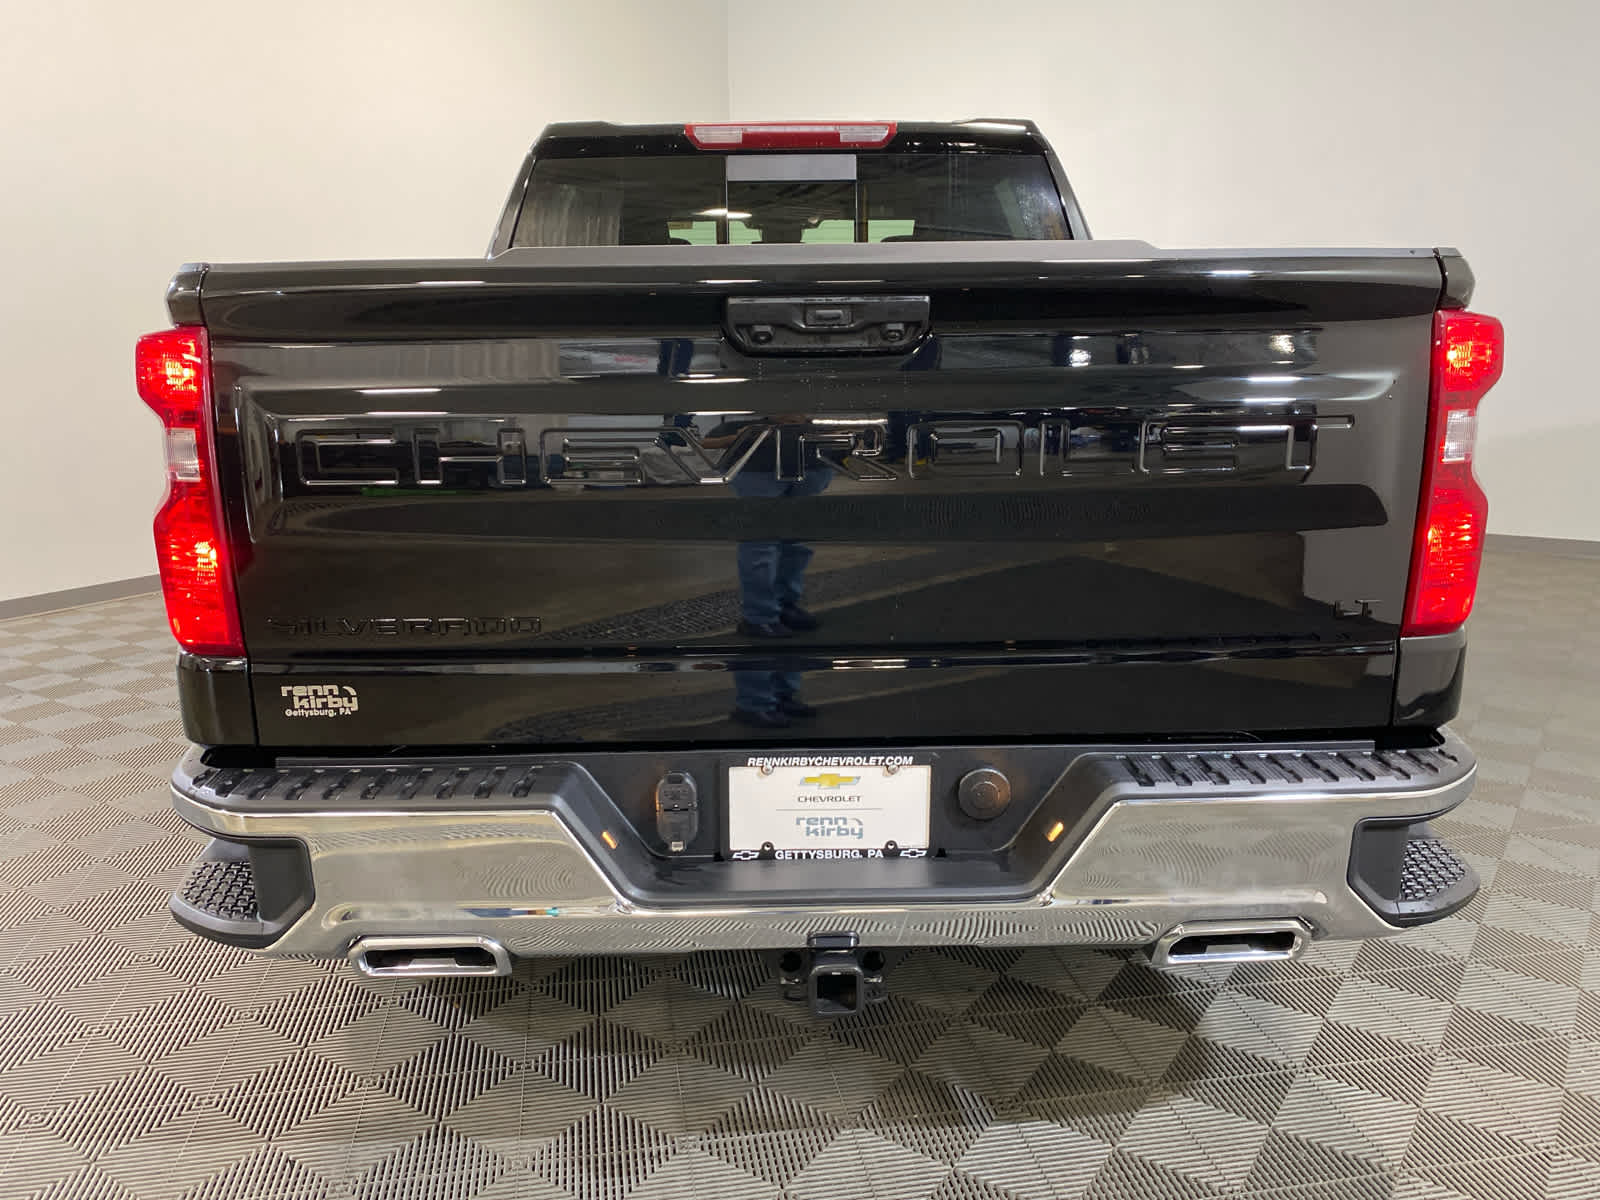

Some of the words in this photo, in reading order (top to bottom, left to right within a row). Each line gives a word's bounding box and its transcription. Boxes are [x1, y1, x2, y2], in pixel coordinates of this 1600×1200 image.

[296, 415, 1355, 486] CHEVROLET
[265, 616, 542, 636] SILVERADO
[281, 685, 339, 696] renn
[293, 695, 358, 711] kirby
[285, 709, 336, 717] Gettysburg,
[747, 756, 914, 767] RENNKIRBYCHEVROLET.COM
[797, 795, 862, 803] CHEVROLET
[795, 816, 848, 826] renn
[805, 825, 863, 839] kirby
[868, 850, 884, 858] PA
